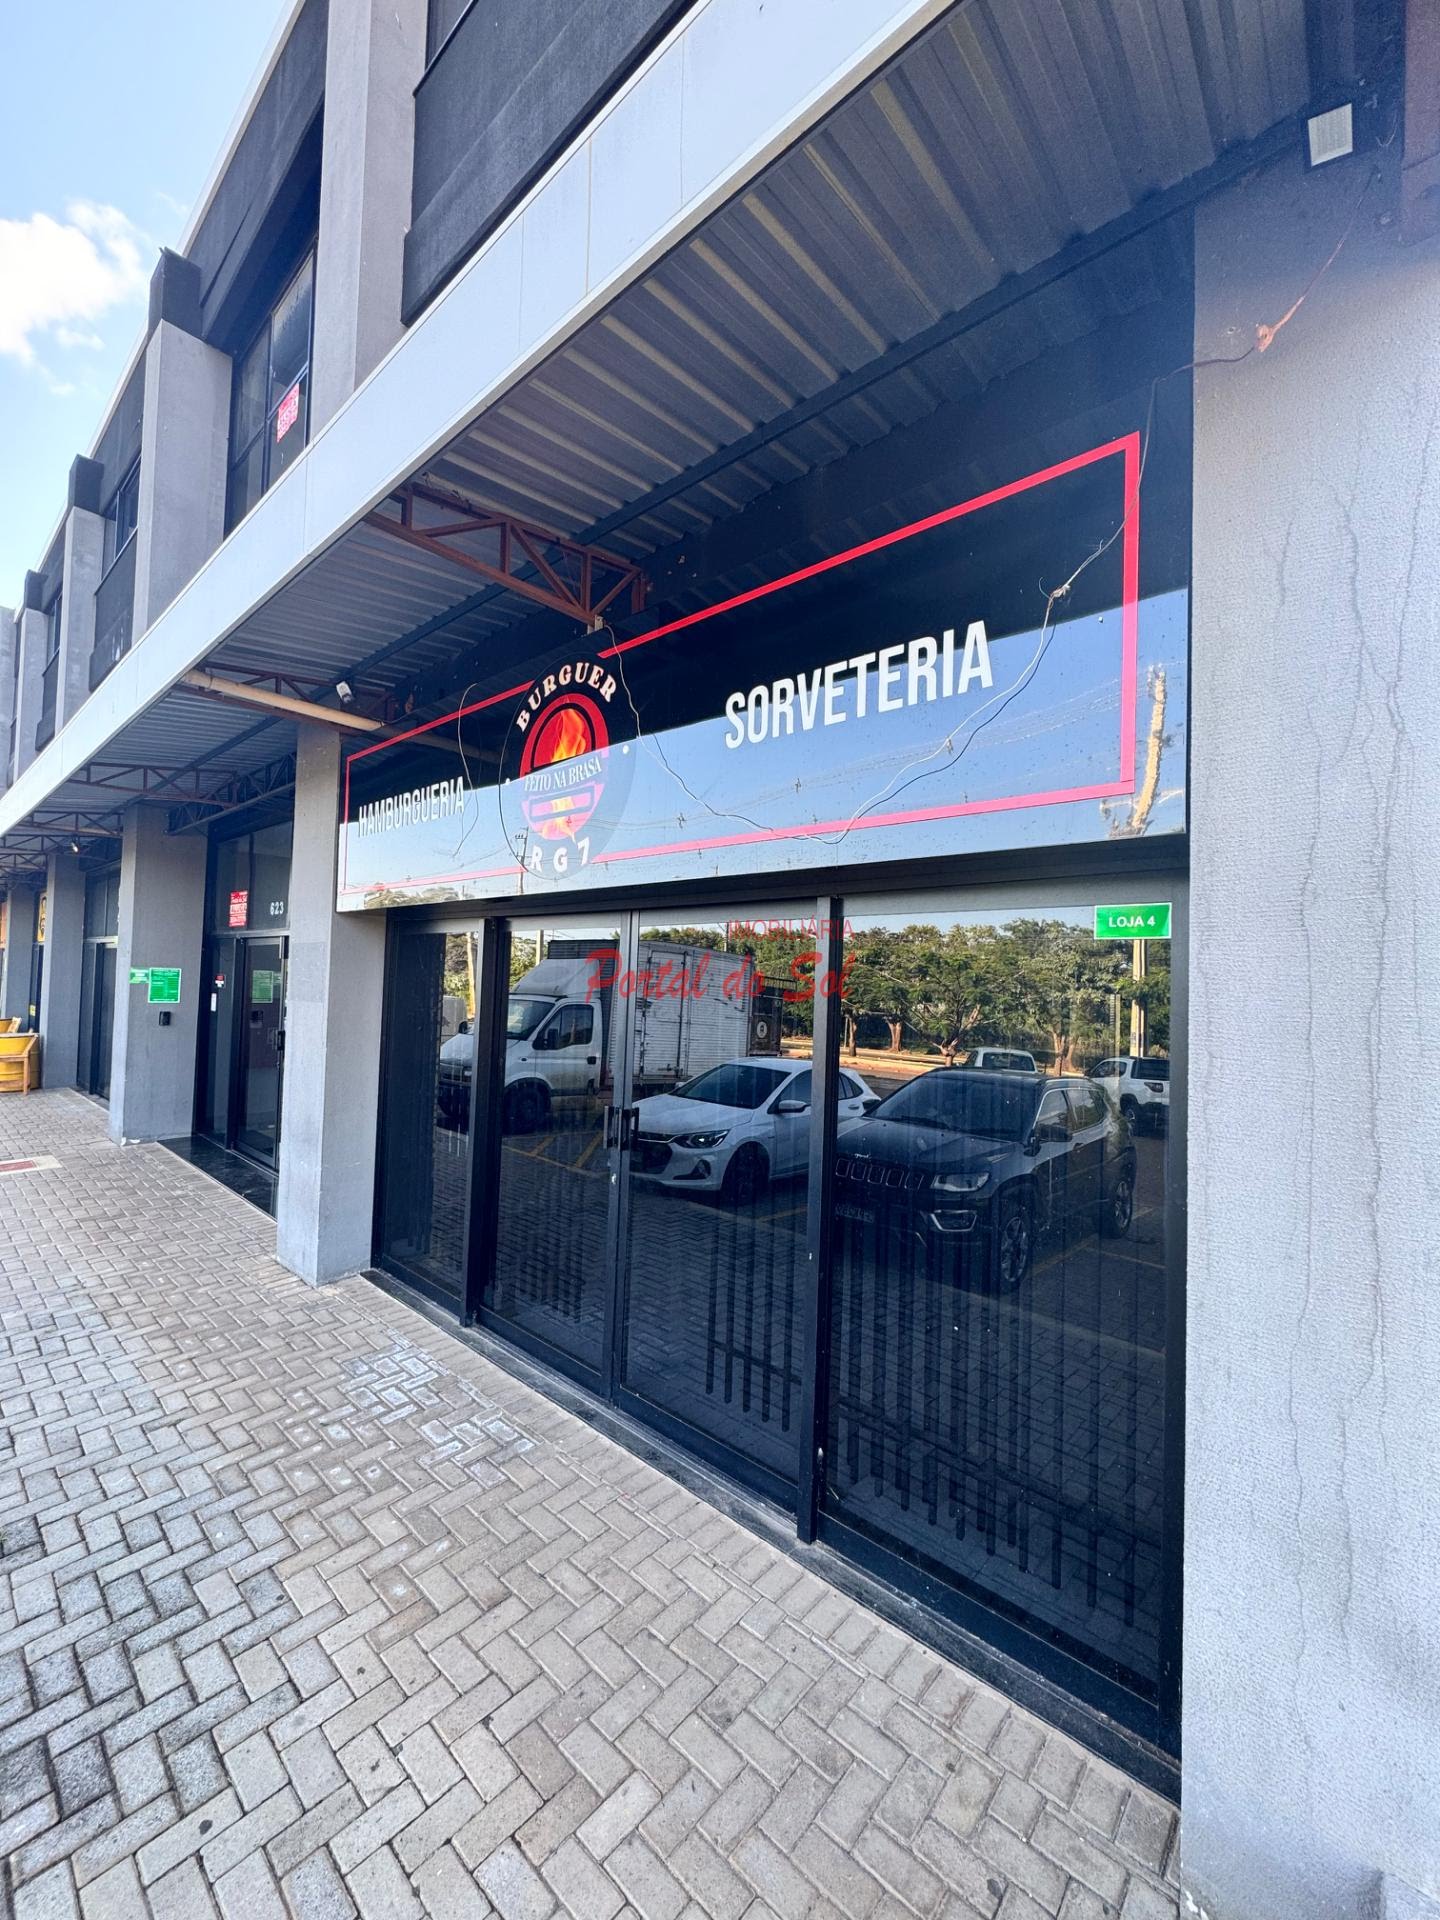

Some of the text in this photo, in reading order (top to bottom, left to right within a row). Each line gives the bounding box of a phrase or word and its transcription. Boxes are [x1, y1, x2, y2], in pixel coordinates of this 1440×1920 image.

[516, 662, 616, 733] BURGUER
[725, 620, 994, 749] SORVETERIA
[524, 756, 602, 792] FEITO NA BRASA
[359, 776, 465, 838] HAMBURGUERIA
[270, 901, 284, 916] 623
[1108, 915, 1156, 928] LOJA 4
